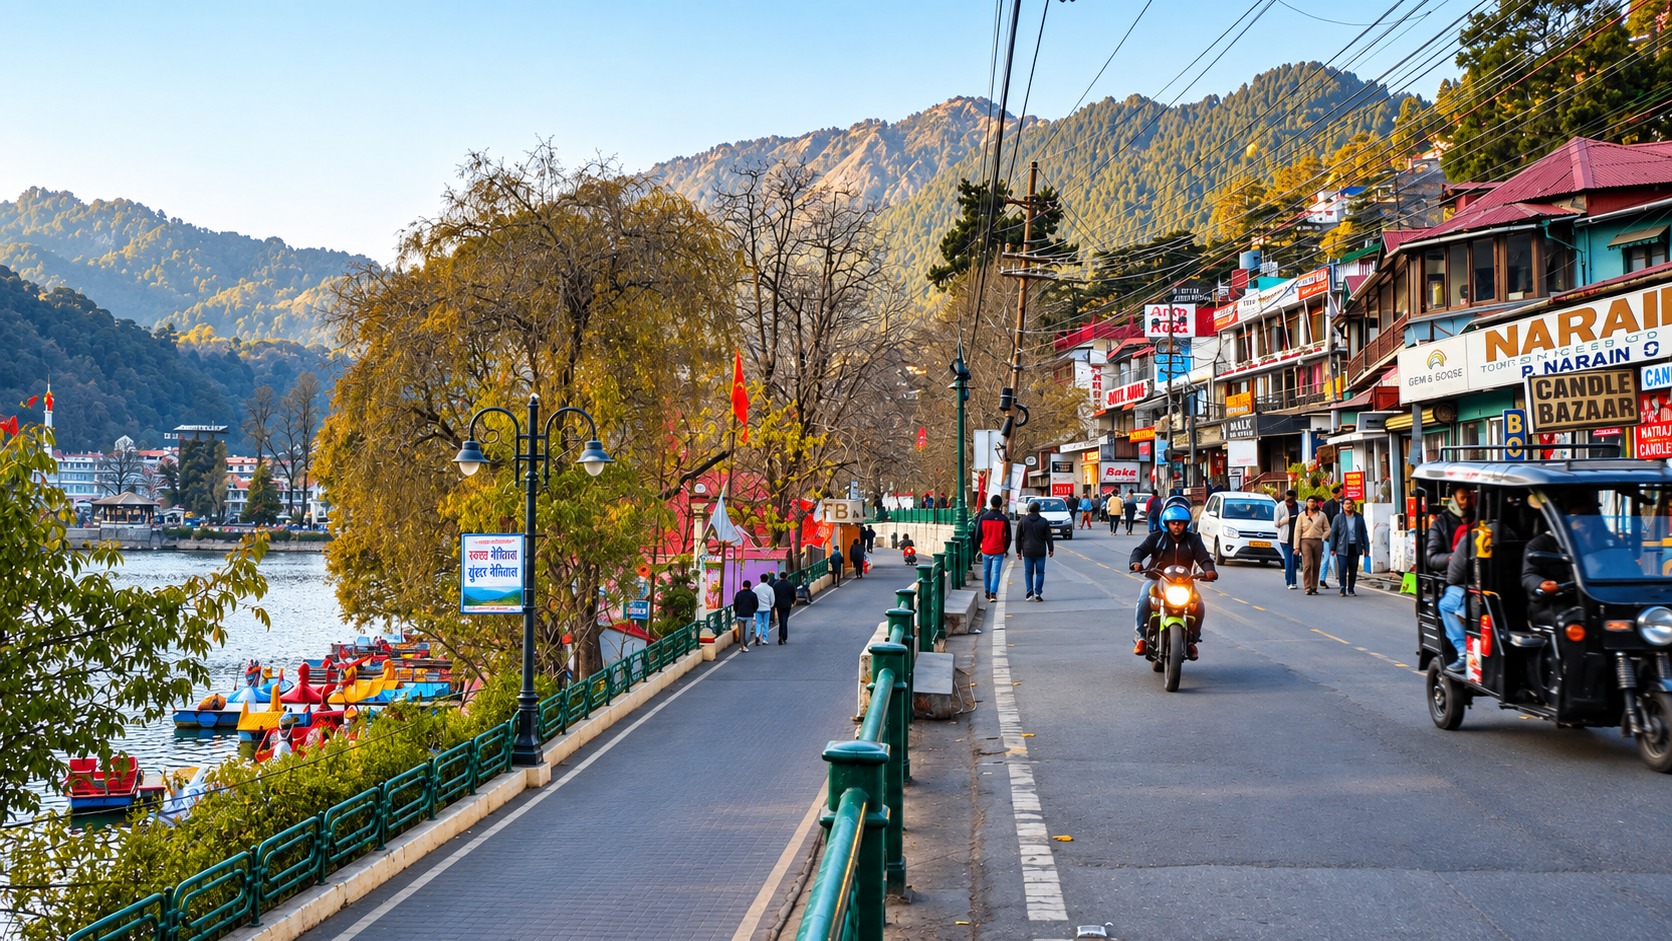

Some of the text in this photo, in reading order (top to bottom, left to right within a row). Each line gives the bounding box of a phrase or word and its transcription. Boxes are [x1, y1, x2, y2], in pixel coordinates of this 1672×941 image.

[1544, 346, 1630, 374] NARAIN
[1408, 375, 1426, 386] GEM
[1536, 373, 1632, 400] CANDLE
[1538, 398, 1635, 424] BAZAAR
